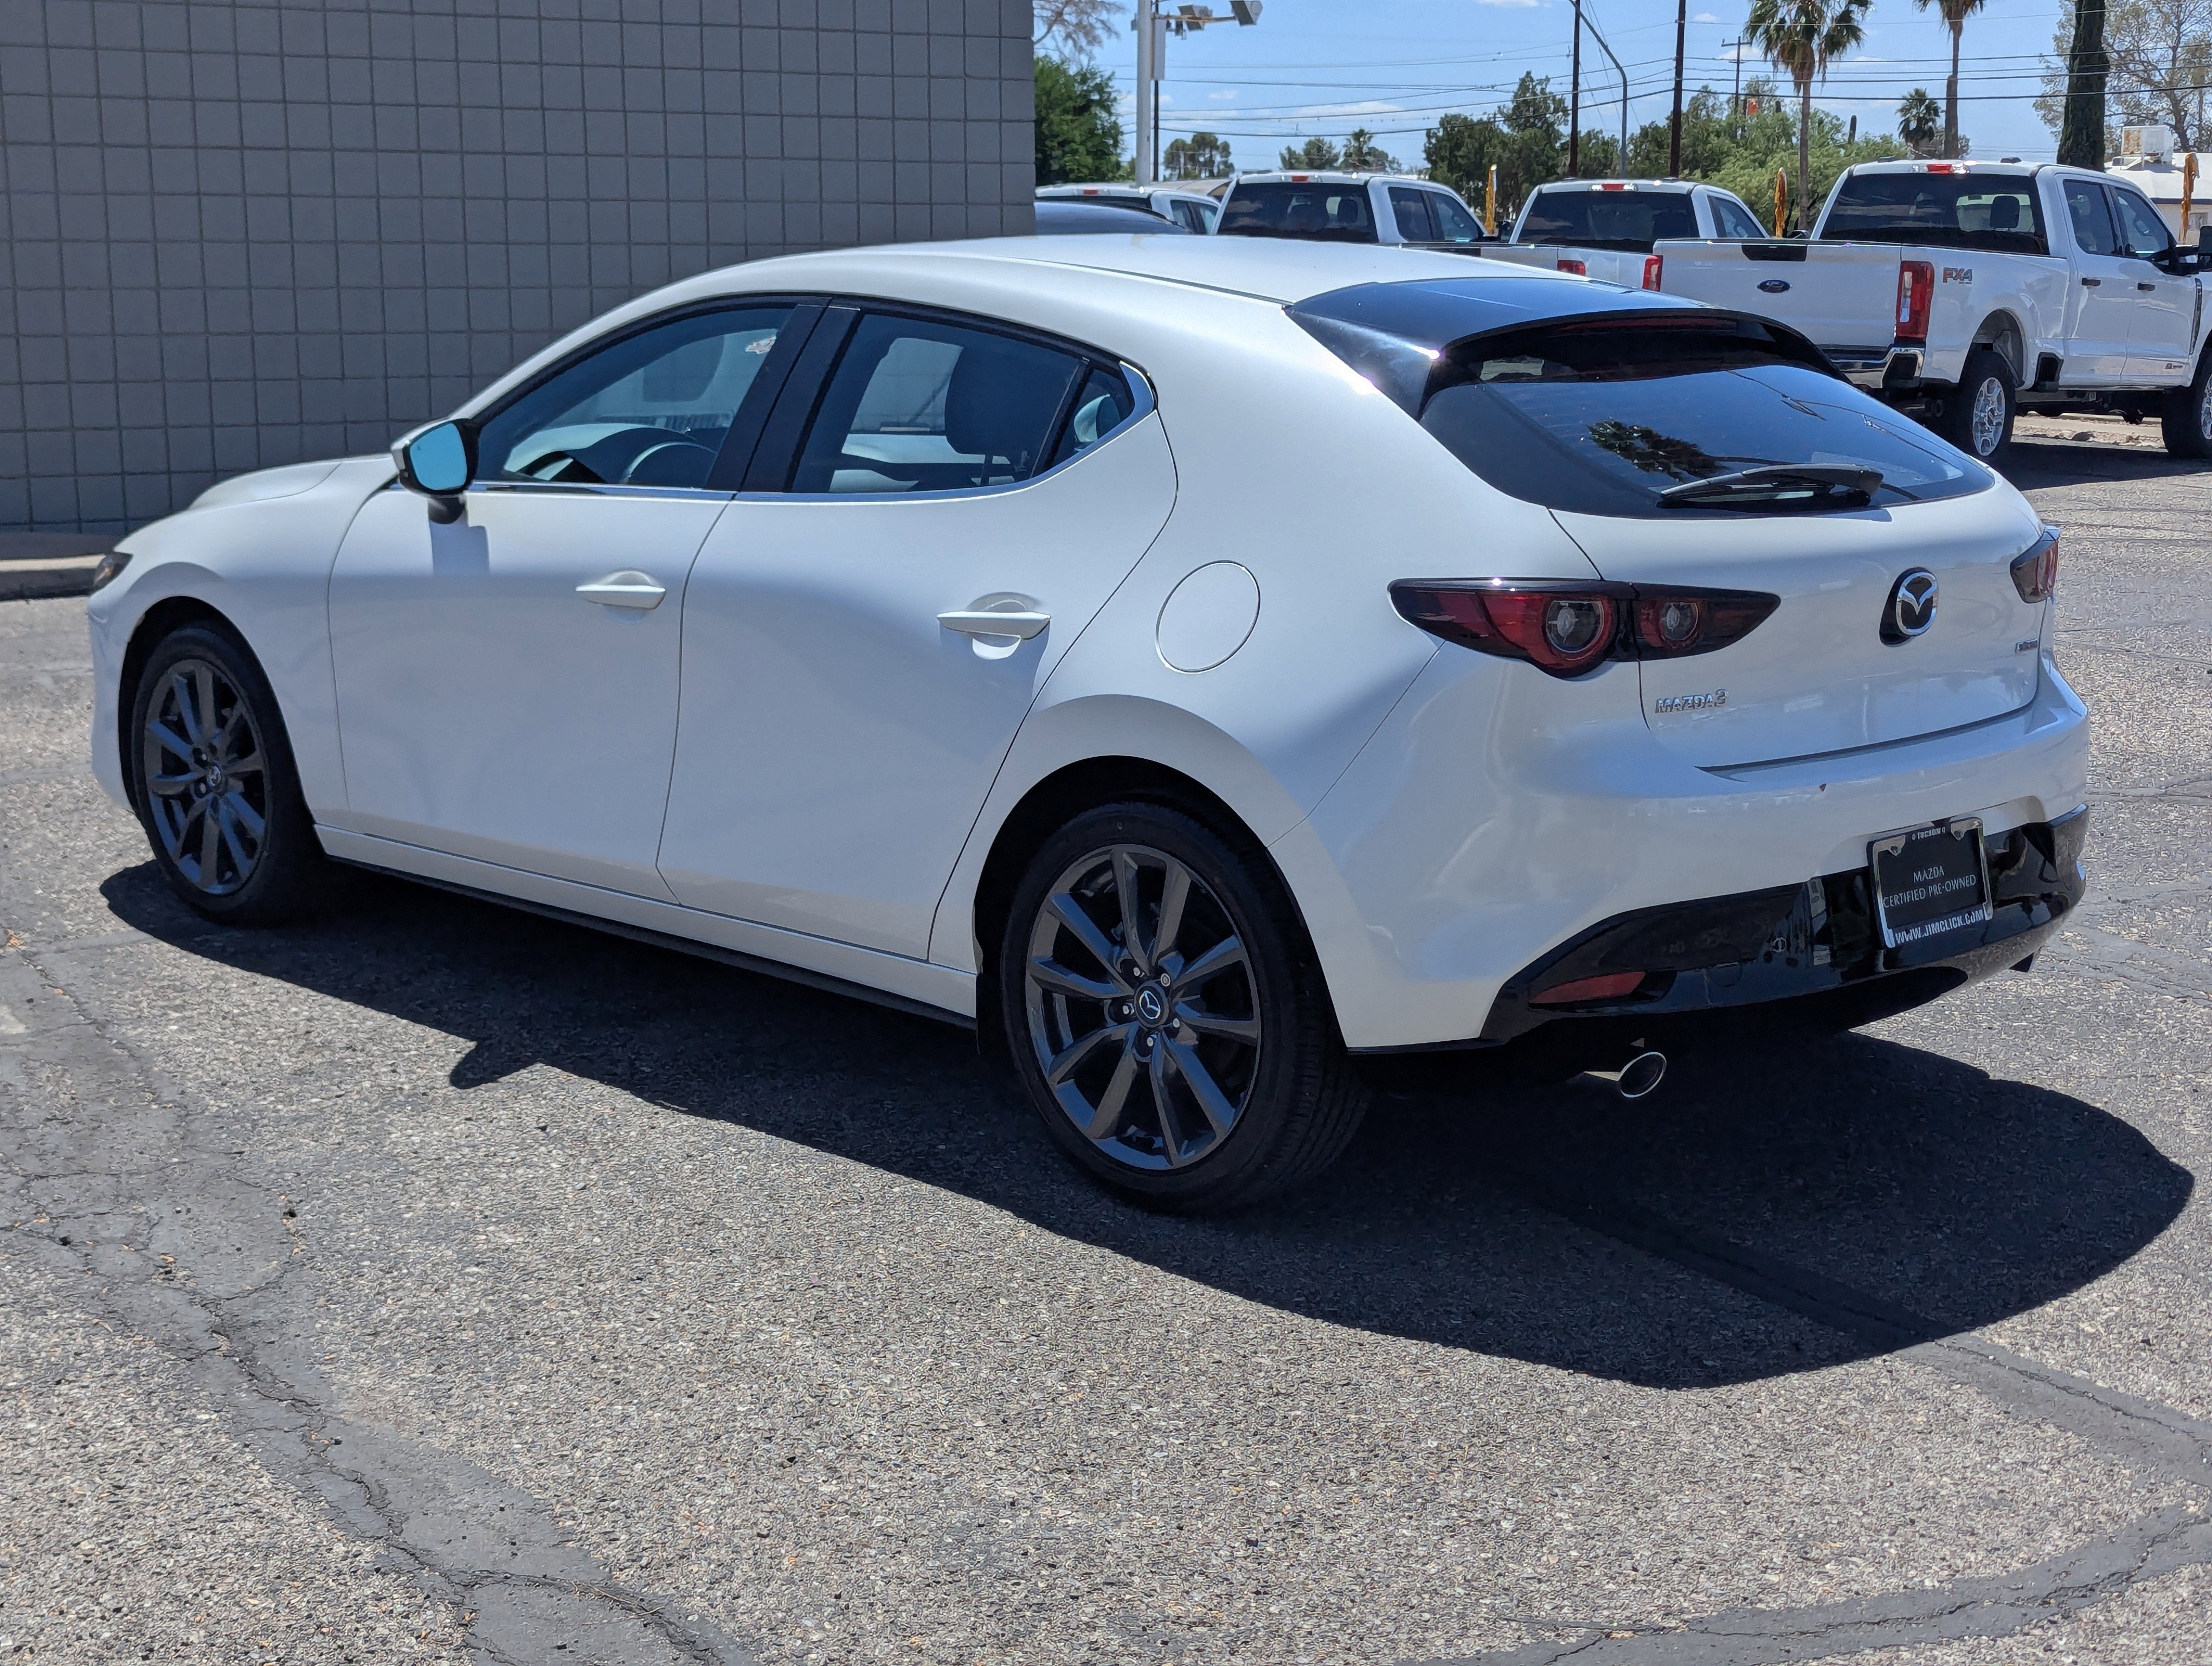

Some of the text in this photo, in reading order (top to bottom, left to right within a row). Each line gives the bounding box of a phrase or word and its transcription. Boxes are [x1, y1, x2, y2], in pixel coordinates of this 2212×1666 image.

[1943, 267, 1973, 283] FX4
[1913, 866, 1945, 883] MAZDA
[1883, 875, 1976, 908] CERTIFIED PRE-OWNED
[1895, 909, 1984, 944] WWW.JIMCLICK.COM
